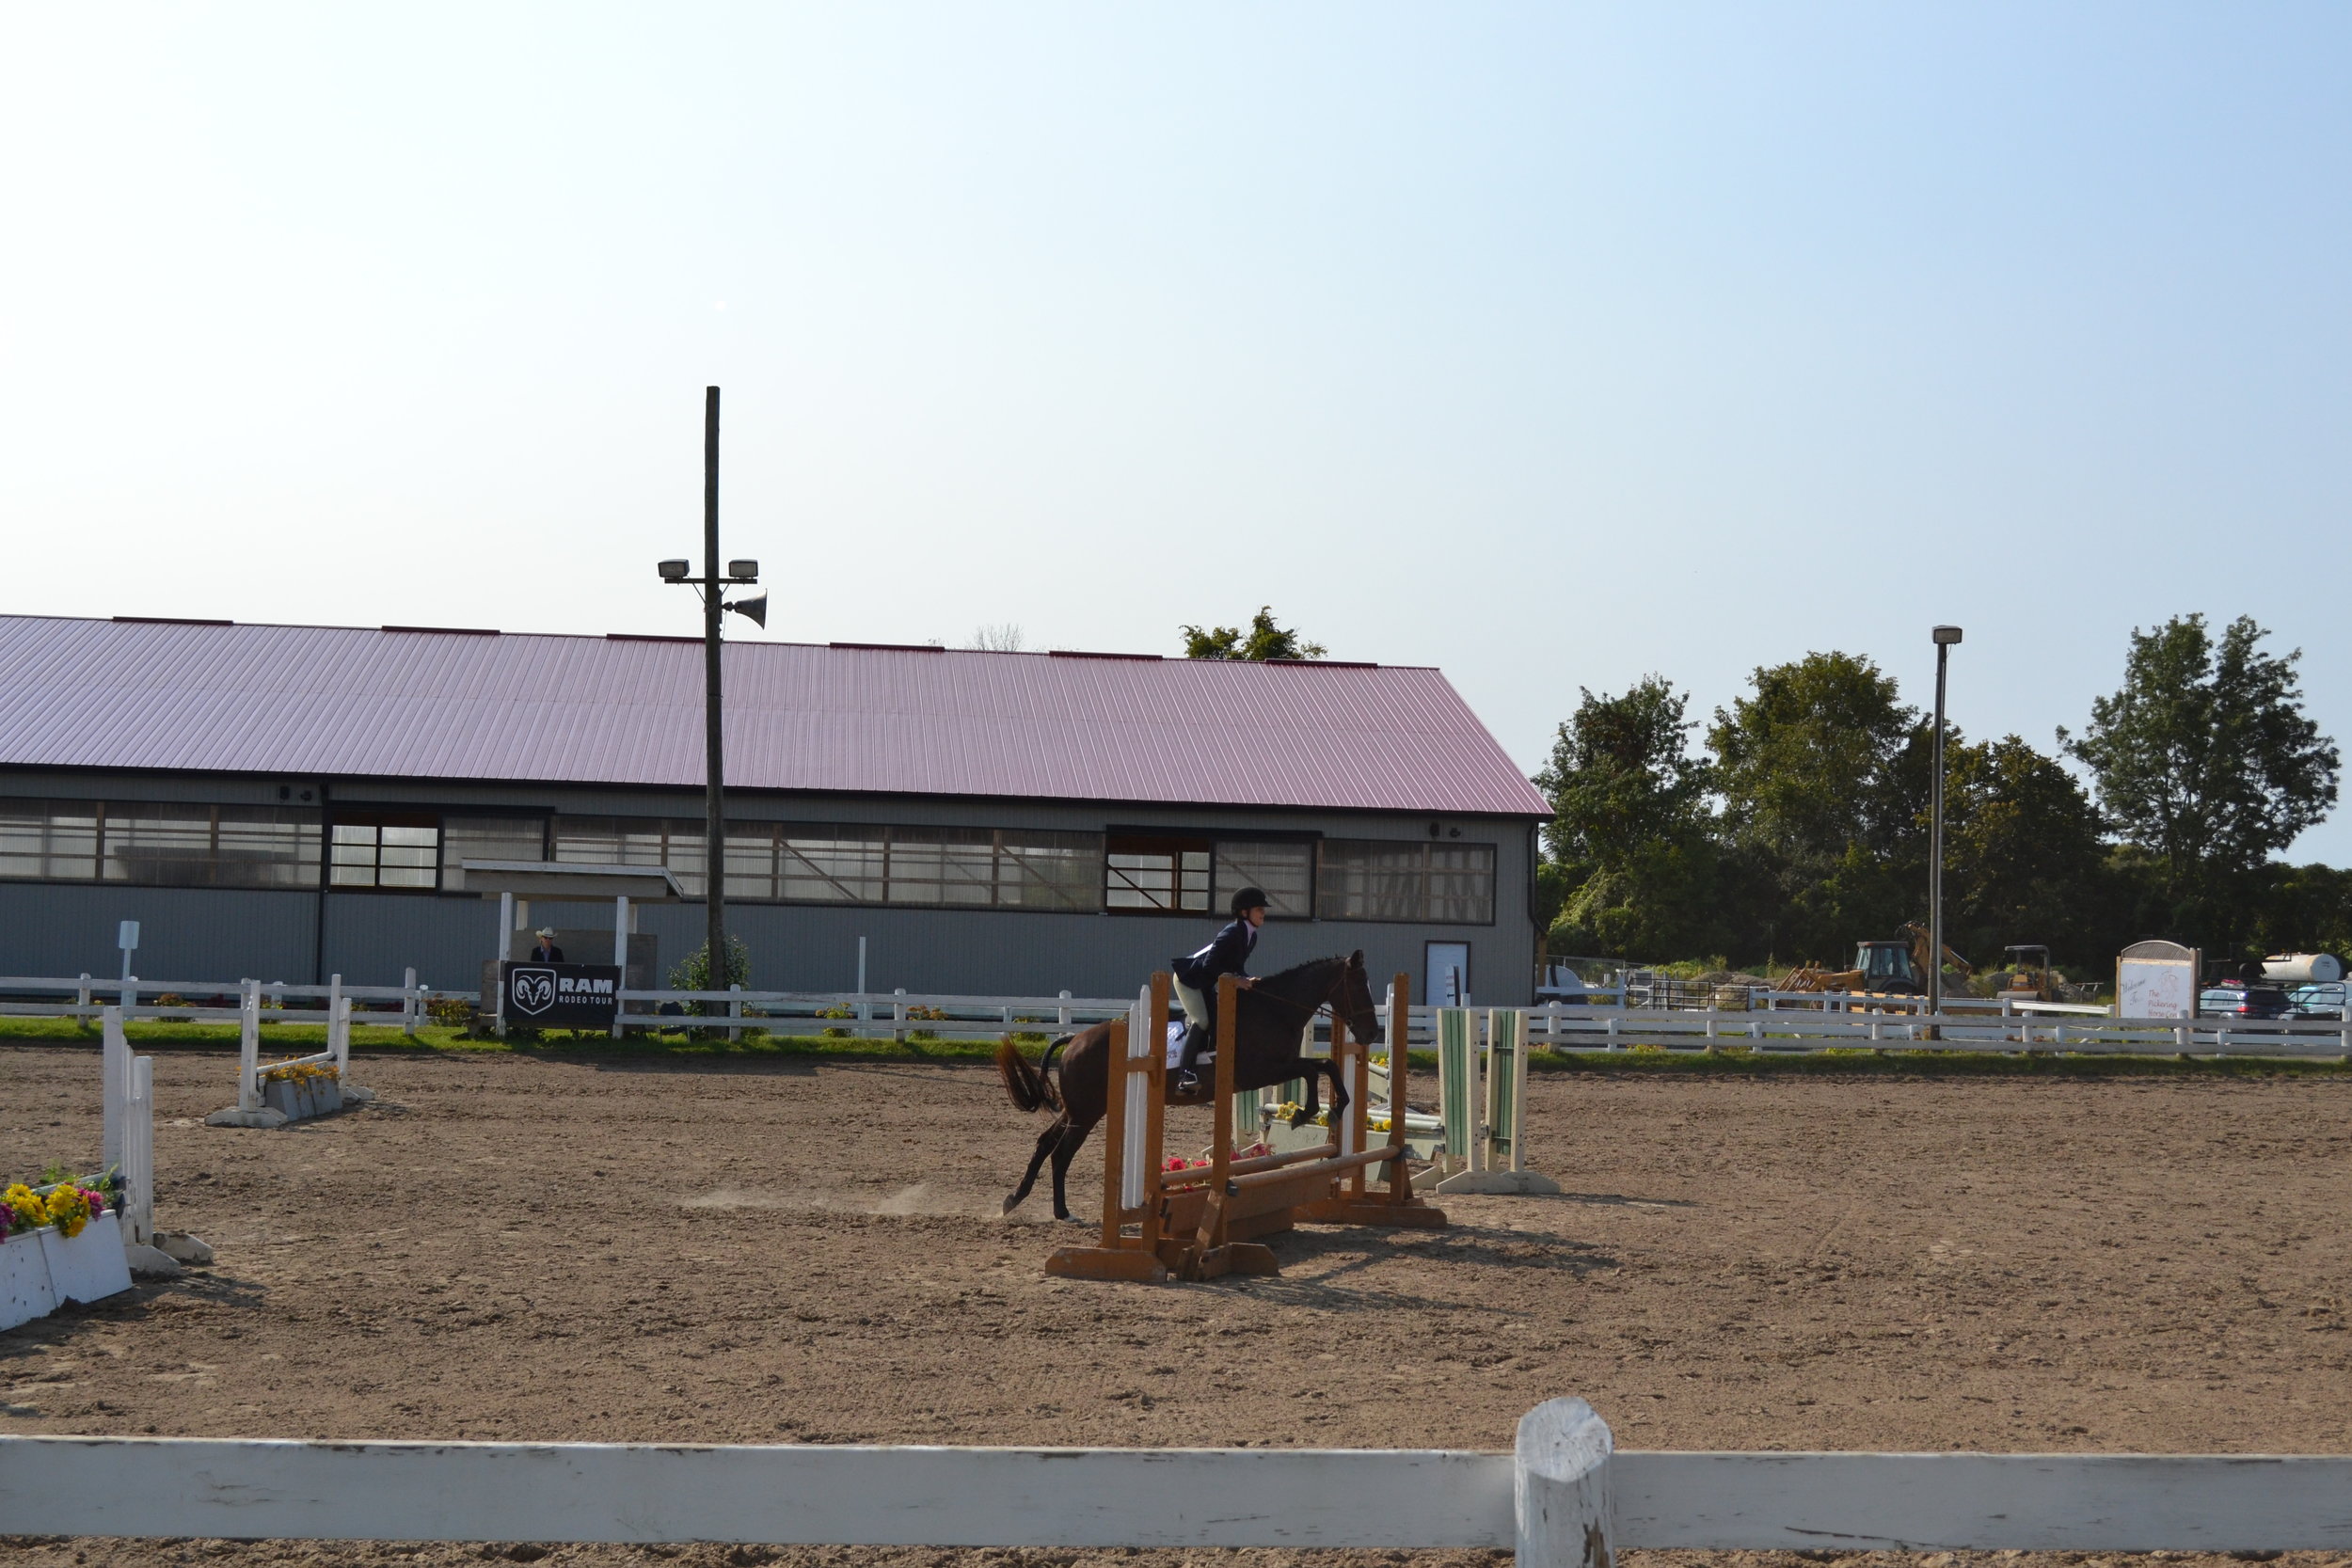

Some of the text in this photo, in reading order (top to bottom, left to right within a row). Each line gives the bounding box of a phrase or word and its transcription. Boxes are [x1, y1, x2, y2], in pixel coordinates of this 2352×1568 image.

[559, 977, 613, 993] RAM
[2149, 989, 2160, 998] The
[559, 995, 612, 1005] RODEO TOUR
[2148, 999, 2177, 1010] Pickering
